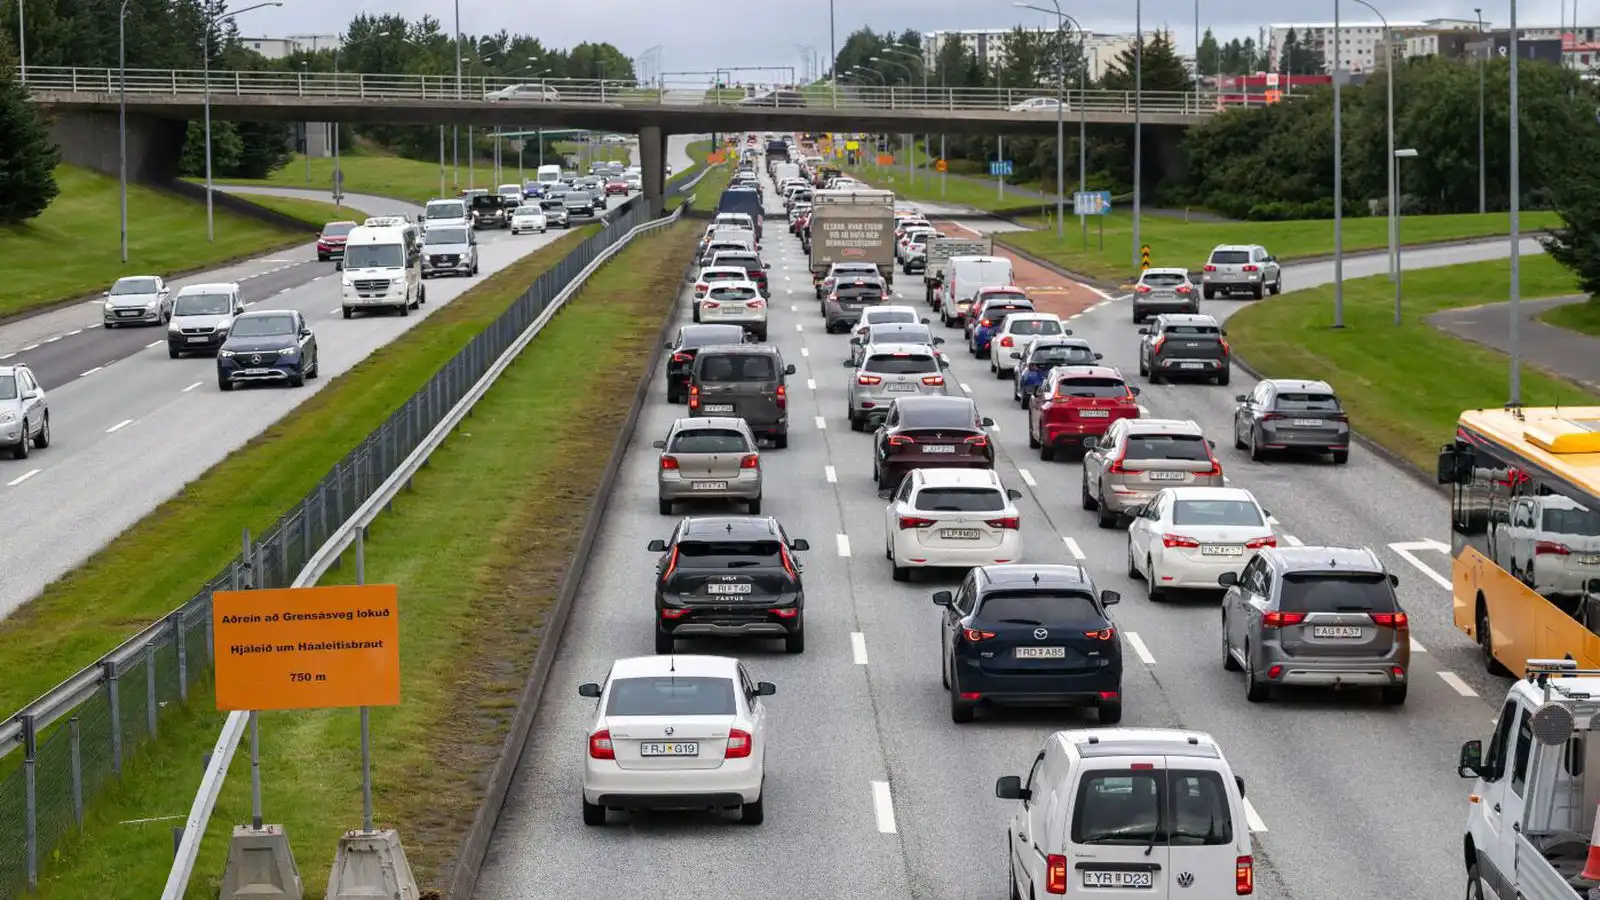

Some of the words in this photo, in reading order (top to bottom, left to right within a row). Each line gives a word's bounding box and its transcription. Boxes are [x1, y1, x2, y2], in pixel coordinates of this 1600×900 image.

[222, 614, 261, 624] Aðrein
[264, 613, 279, 622] að
[283, 610, 353, 621] Grensásveg
[356, 608, 390, 618] lokuð
[276, 645, 294, 653] um
[298, 640, 384, 651] Háaleitisbraut
[1023, 648, 1037, 657] RD
[1044, 648, 1064, 657] A85
[290, 672, 312, 682] 750
[315, 673, 326, 681] m
[651, 744, 666, 753] RJ
[674, 744, 695, 754] G19
[1094, 872, 1112, 883] YR
[1123, 873, 1149, 885] D23
